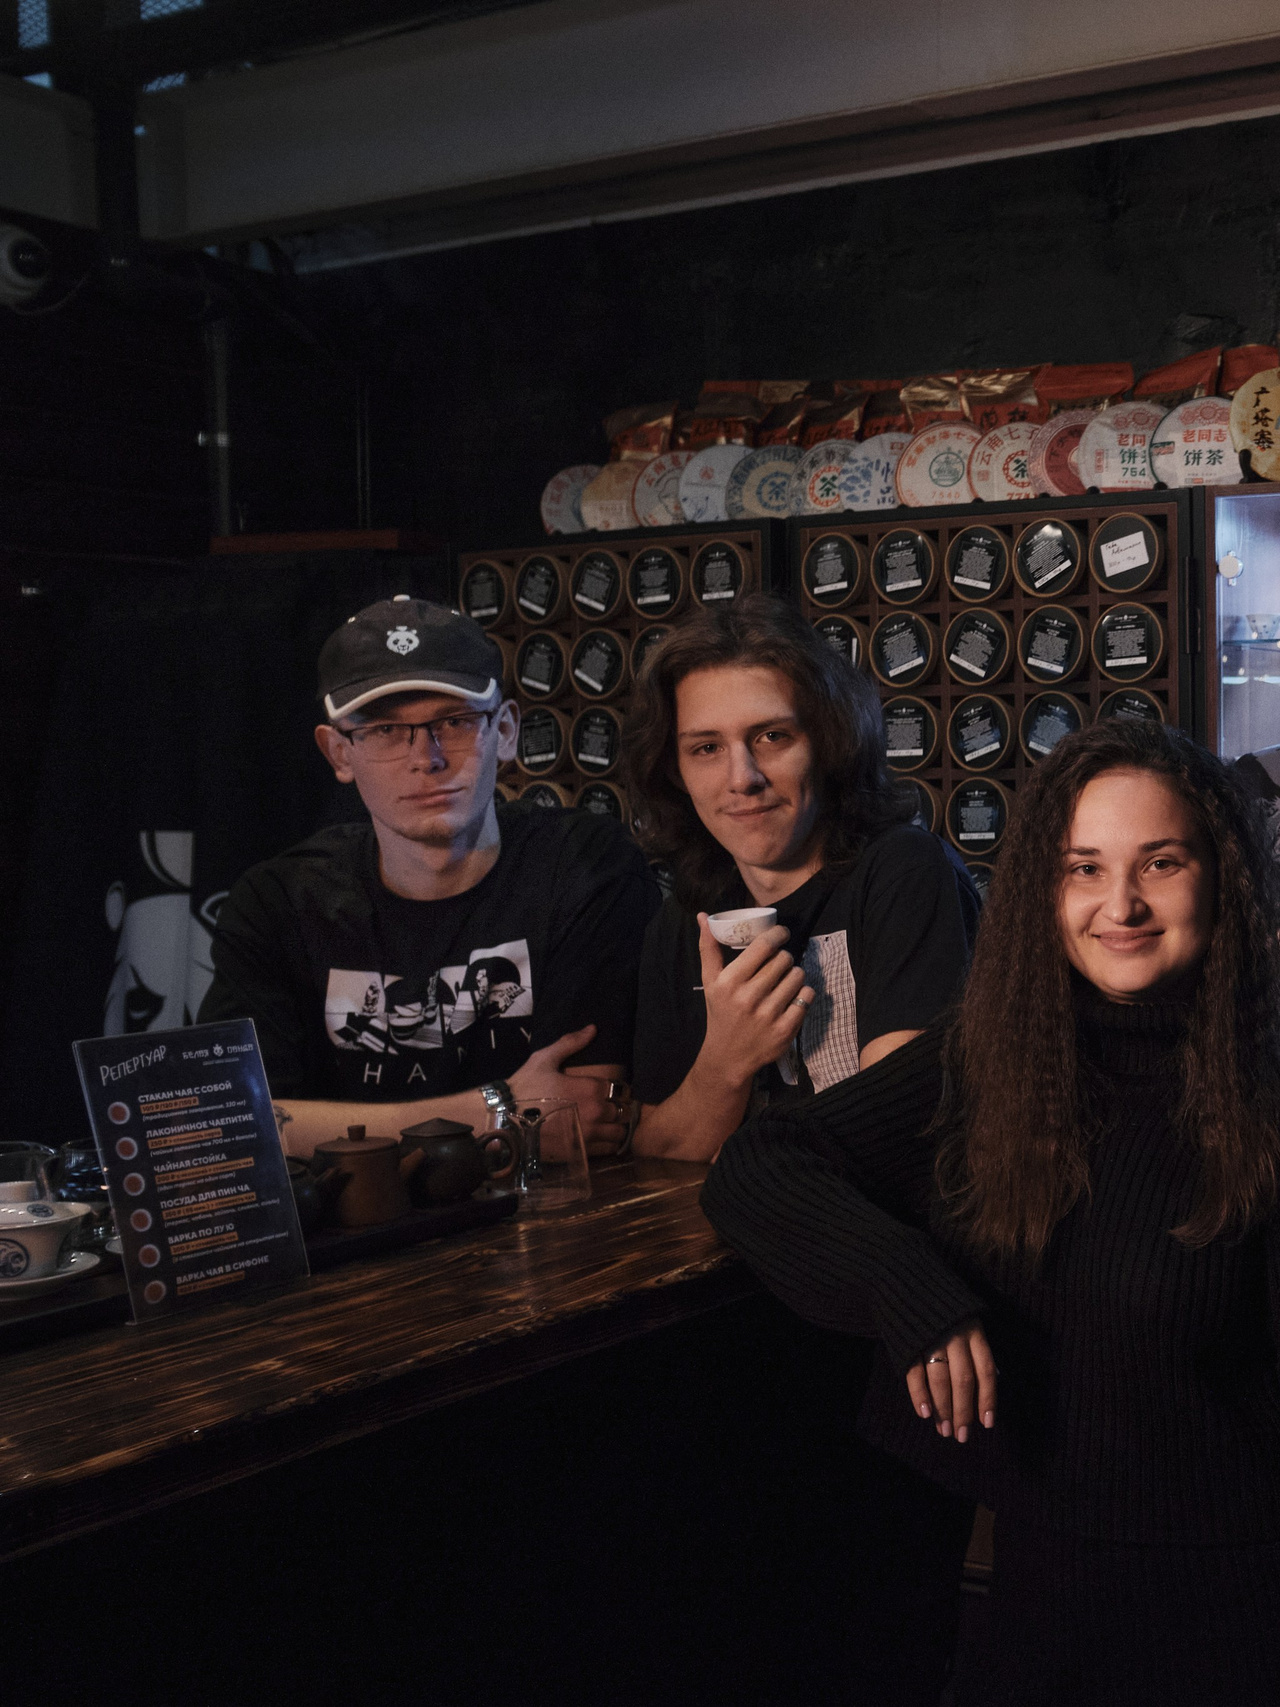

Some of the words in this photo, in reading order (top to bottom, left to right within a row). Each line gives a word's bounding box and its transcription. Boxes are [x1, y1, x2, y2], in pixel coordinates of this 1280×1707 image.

[1117, 433, 1147, 446] 老同
[1182, 429, 1228, 443] 老同志
[1184, 449, 1224, 466] 饼茶
[138, 1091, 174, 1103] СТАКАН
[175, 1088, 192, 1097] ЧАЯ
[200, 1080, 232, 1093] СОБОЙ
[145, 1121, 209, 1138] ЛАКОНИЧНОЕ
[208, 1113, 254, 1127] ЧАЕПИТИЕ
[153, 1158, 191, 1173] ЧАЙНАЯ
[191, 1151, 227, 1166] СТОЙКА
[160, 1195, 197, 1209] ПОСУДА
[197, 1191, 217, 1201] ДЛЯ
[217, 1187, 237, 1197] ПИН
[238, 1184, 250, 1192] ЧА
[168, 1231, 199, 1245] ВАРКА
[198, 1228, 213, 1237] ПО
[214, 1225, 225, 1234] ЛУ
[226, 1223, 235, 1231] Ю
[175, 1271, 206, 1284] ВАРКА
[206, 1266, 224, 1277] ЧАЯ
[232, 1255, 270, 1270] СИФОНЕ
